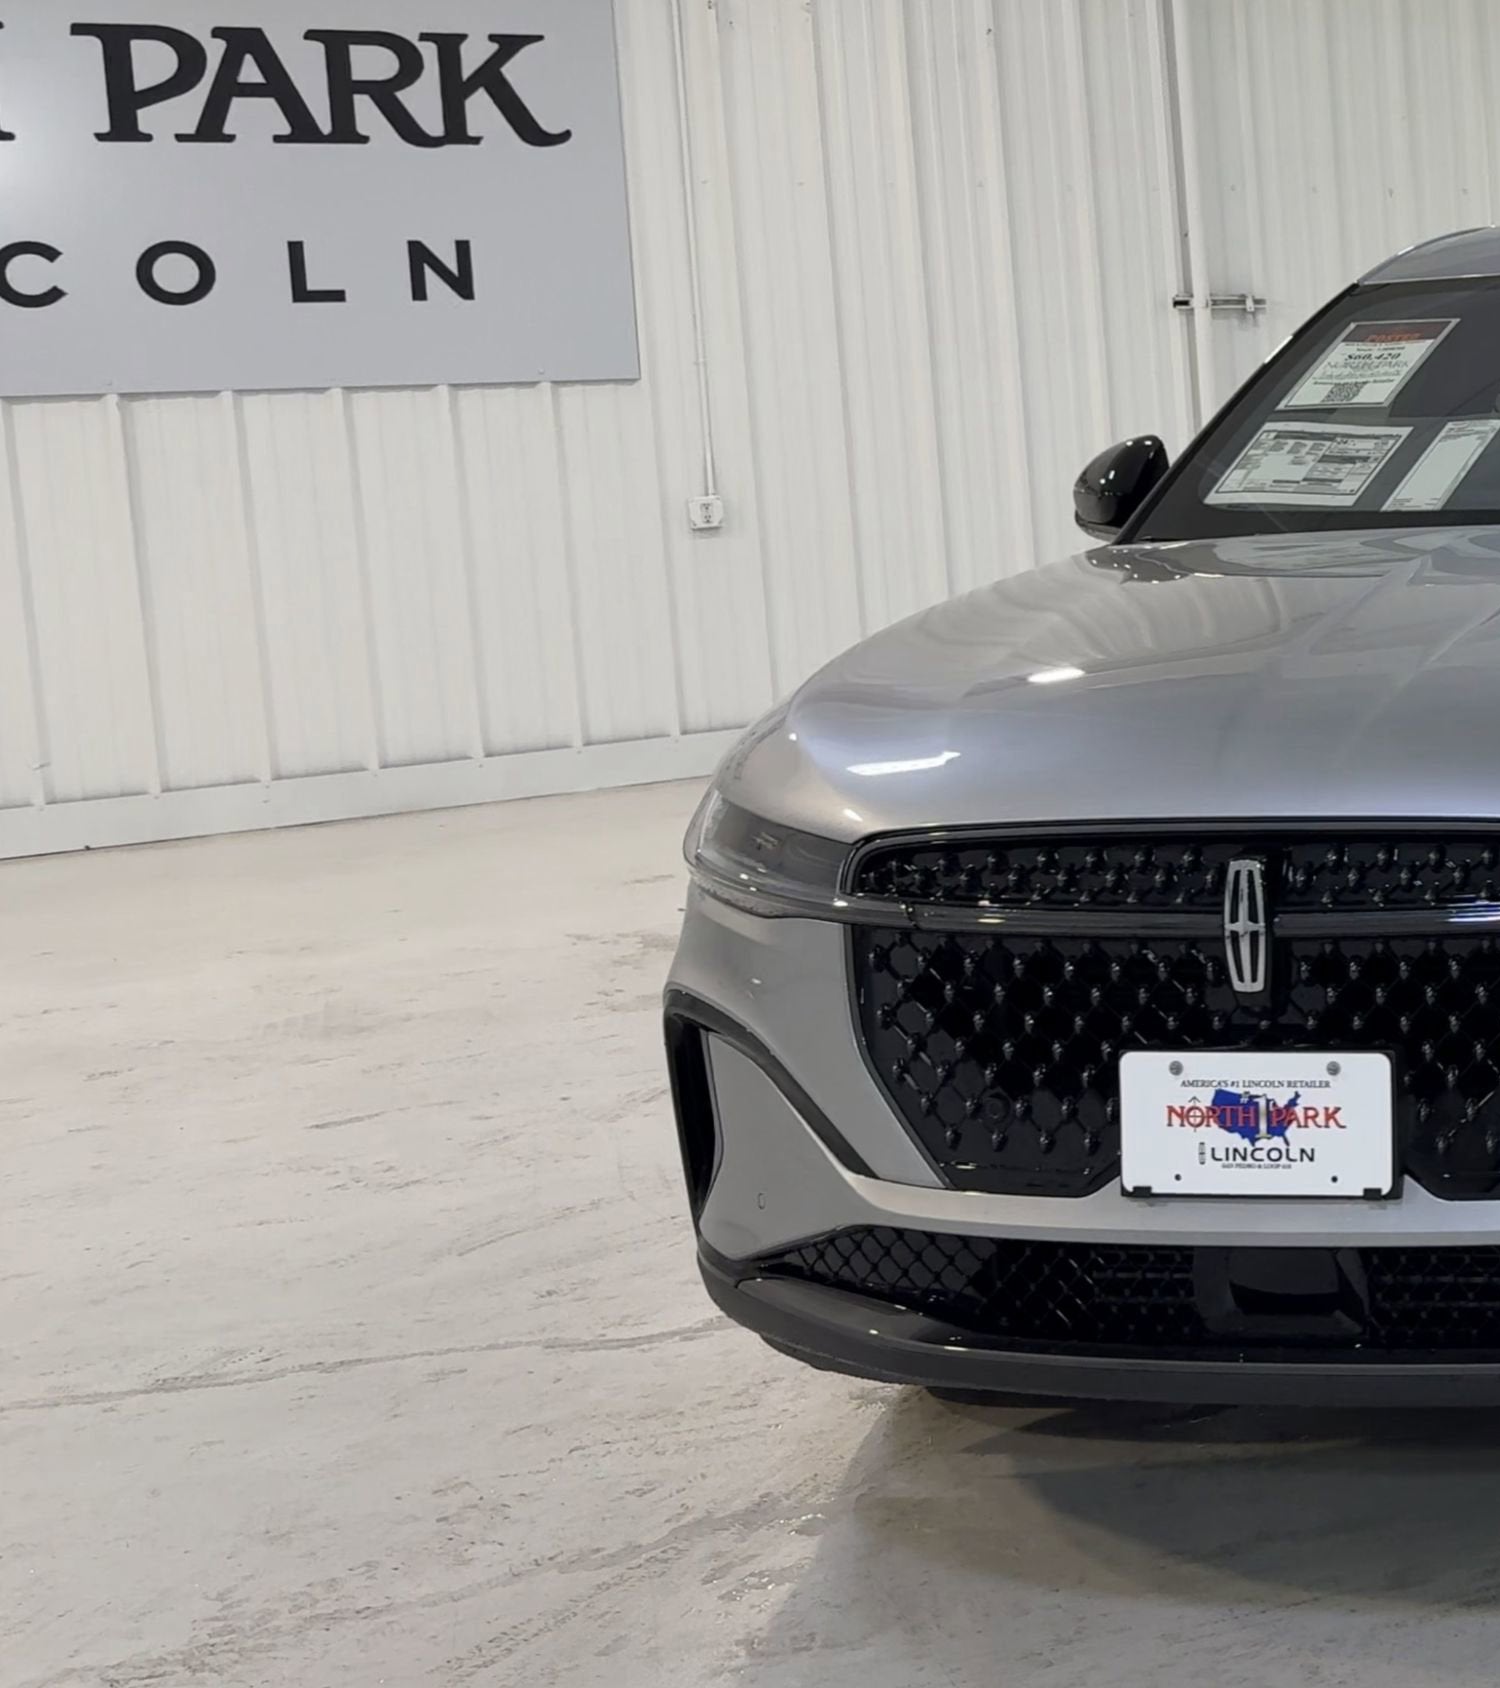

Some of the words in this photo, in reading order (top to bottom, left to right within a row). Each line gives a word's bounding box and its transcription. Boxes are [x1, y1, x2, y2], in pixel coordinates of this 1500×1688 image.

[70, 23, 572, 148] PARK
[1180, 1079, 1229, 1088] AMERICA'S
[1230, 1080, 1240, 1088] #1
[1242, 1079, 1285, 1089] LINCOLN
[1286, 1079, 1331, 1089] RETAILER
[1166, 1104, 1256, 1129] NORTH
[1271, 1105, 1347, 1129] PARK
[1210, 1147, 1315, 1163] LINCOLN
